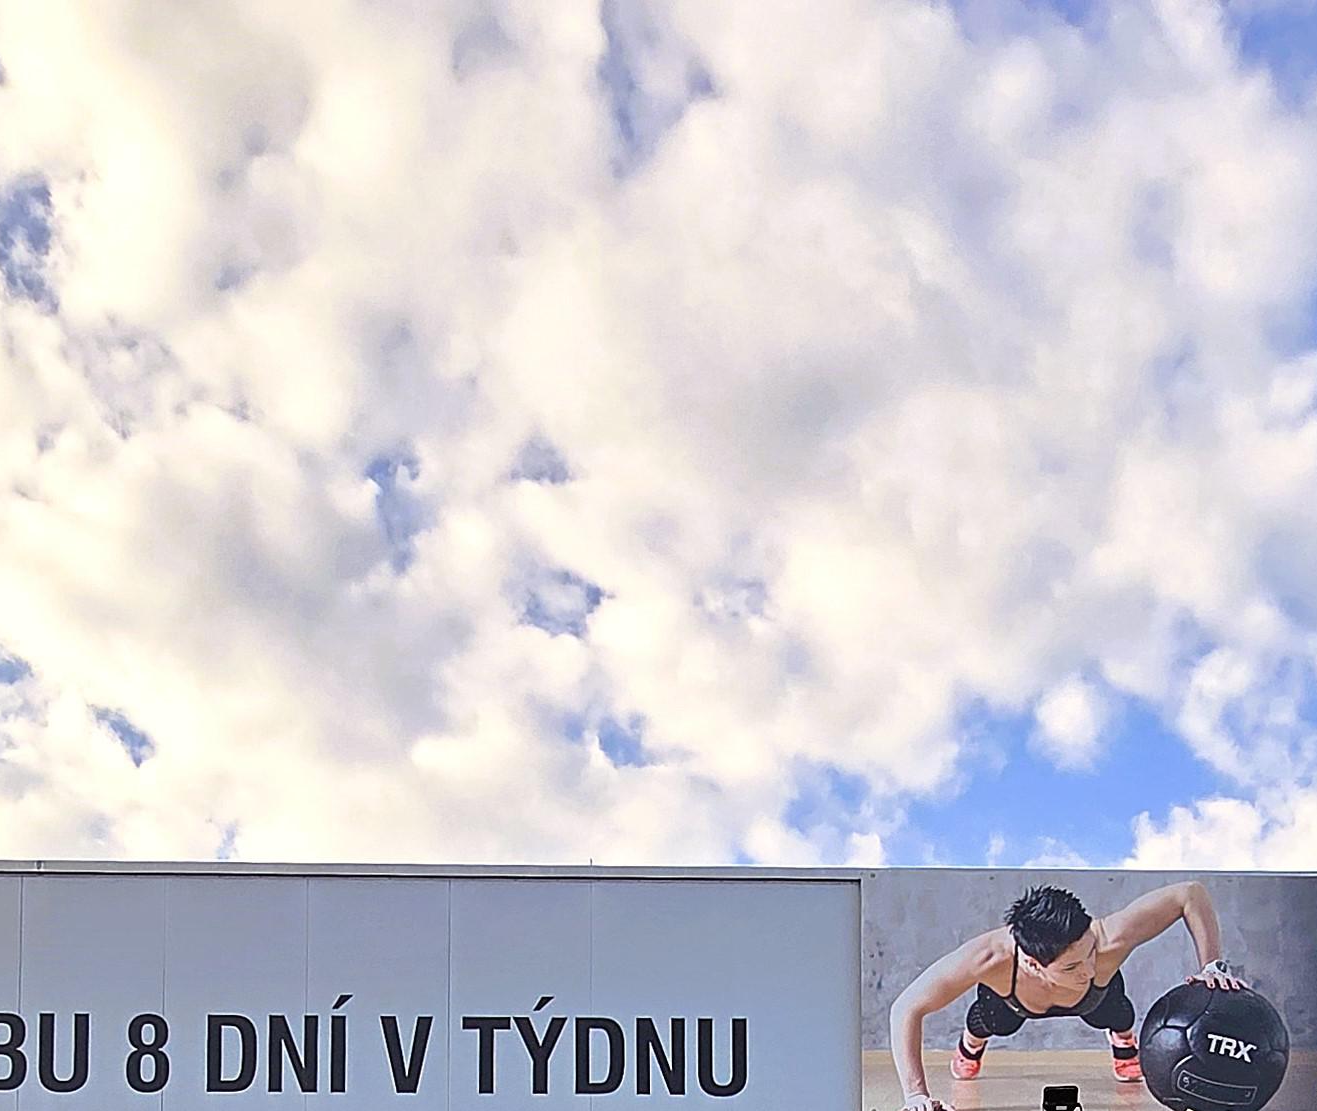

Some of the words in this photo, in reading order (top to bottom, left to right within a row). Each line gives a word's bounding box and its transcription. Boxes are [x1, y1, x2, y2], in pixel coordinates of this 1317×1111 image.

[125, 1013, 170, 1094] 8
[205, 993, 354, 1093] DNÍ
[379, 1015, 433, 1094] V
[461, 996, 748, 1097] TÝDNU
[1207, 1033, 1257, 1063] TRX
